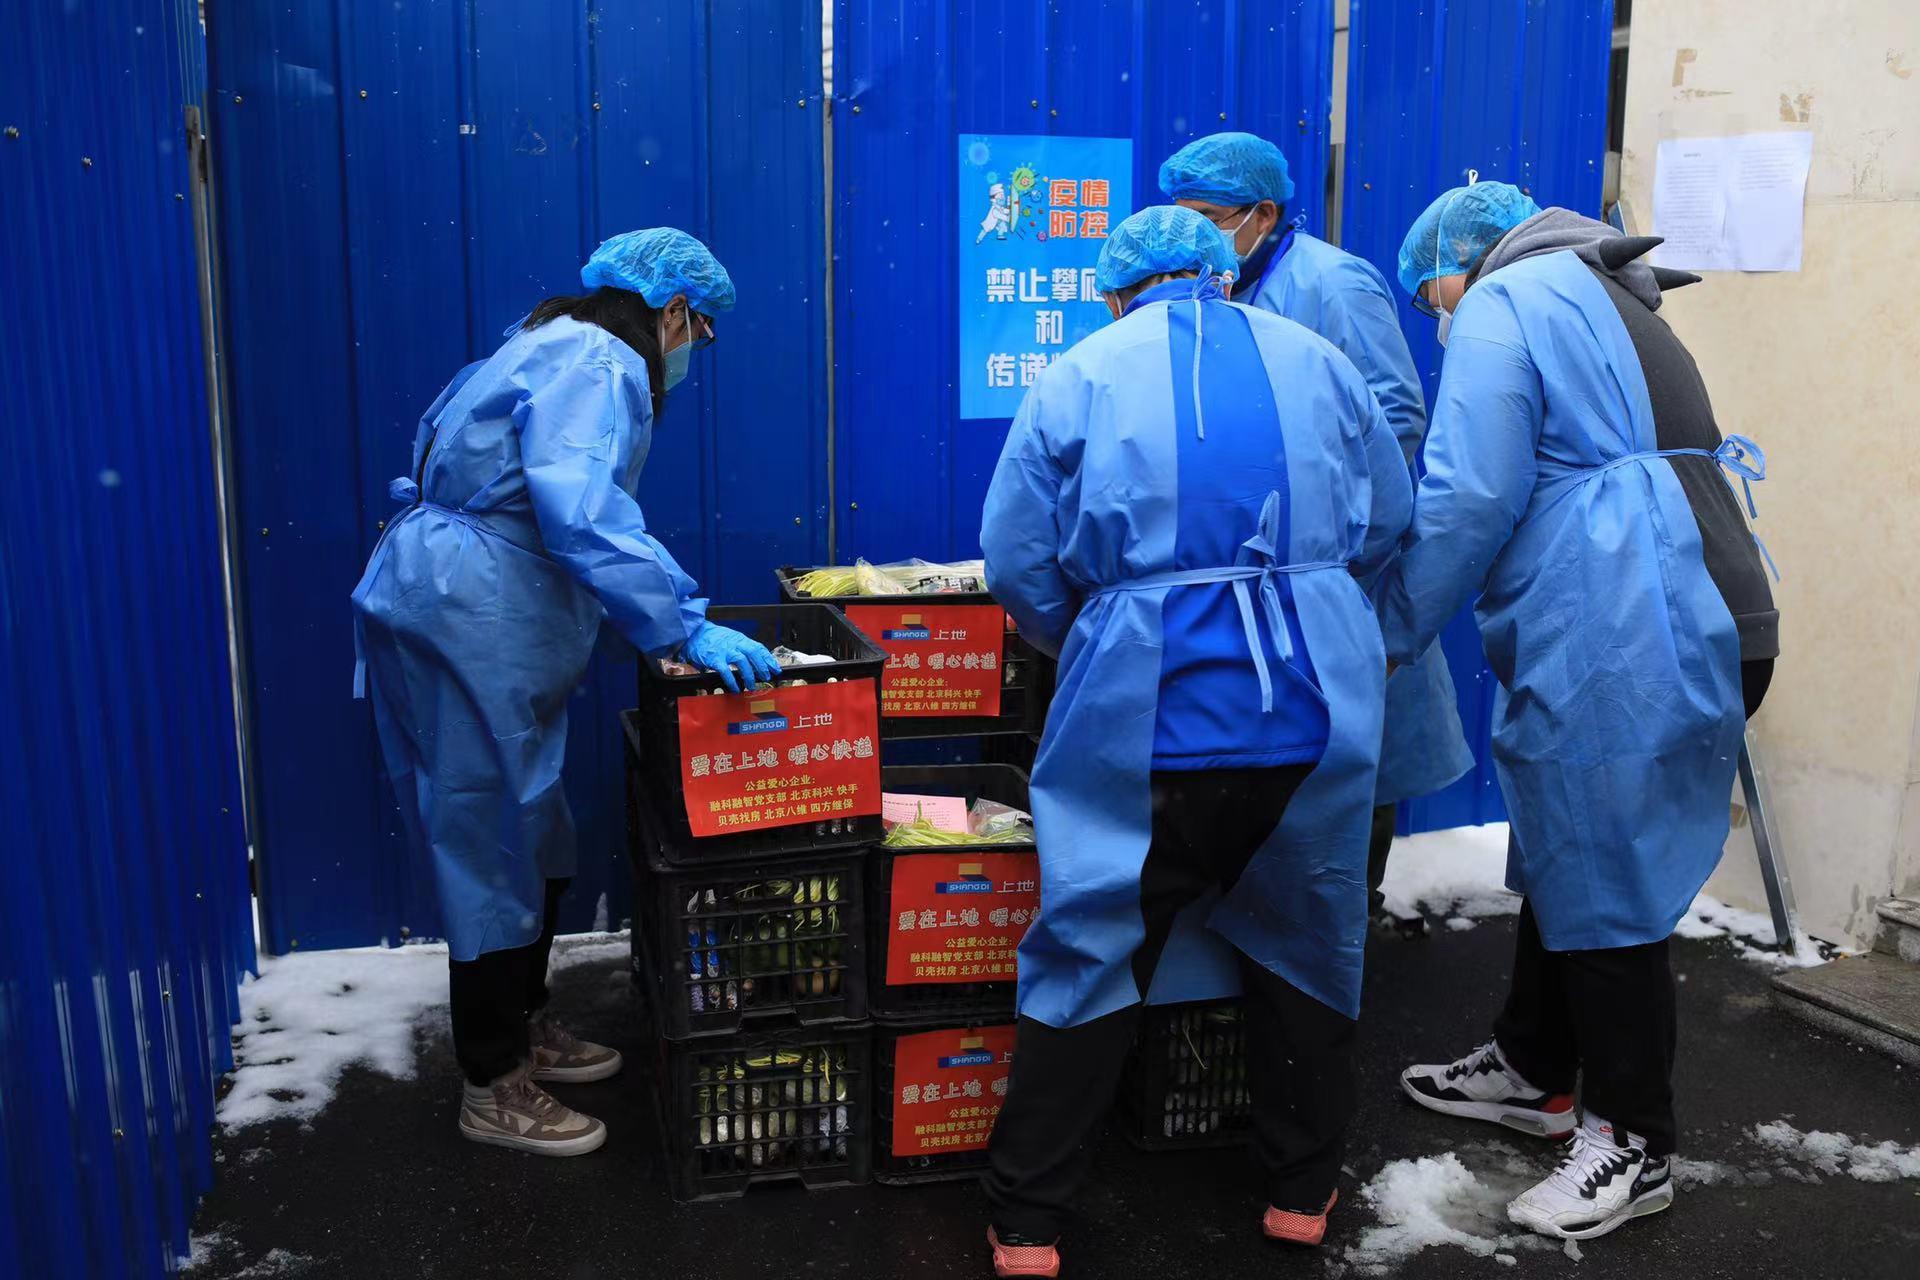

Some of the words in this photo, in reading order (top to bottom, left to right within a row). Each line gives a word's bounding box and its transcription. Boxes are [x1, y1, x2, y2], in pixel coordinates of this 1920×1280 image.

[1049, 179, 1109, 208] 疫情
[1049, 210, 1109, 238] 防控
[1035, 310, 1064, 344] 和
[986, 352, 1061, 387] 传递
[934, 629, 967, 640] 上地
[885, 652, 920, 669] 上地
[928, 651, 997, 670] 暖心快递
[927, 689, 962, 699] 北京科兴
[964, 689, 982, 699] 快手
[793, 712, 833, 729] 上地
[690, 747, 779, 777] 爱在上地
[788, 736, 874, 766] 暖心快递
[709, 791, 787, 813] 融科融智党支部
[790, 785, 834, 801] 北京科兴
[836, 783, 858, 796] 快手
[718, 811, 761, 827] 贝壳找房
[764, 804, 808, 820] 北京八维
[996, 879, 1035, 893] 上地
[898, 907, 980, 931] 爱在上地
[910, 951, 984, 963] 融科融智党支部
[915, 965, 957, 977] 贝壳找房
[960, 963, 1001, 976] 北京八维
[902, 1079, 982, 1104] 爱在上地
[914, 1120, 987, 1136] 融科融智党支部
[920, 1134, 961, 1148] 贝壳找房
